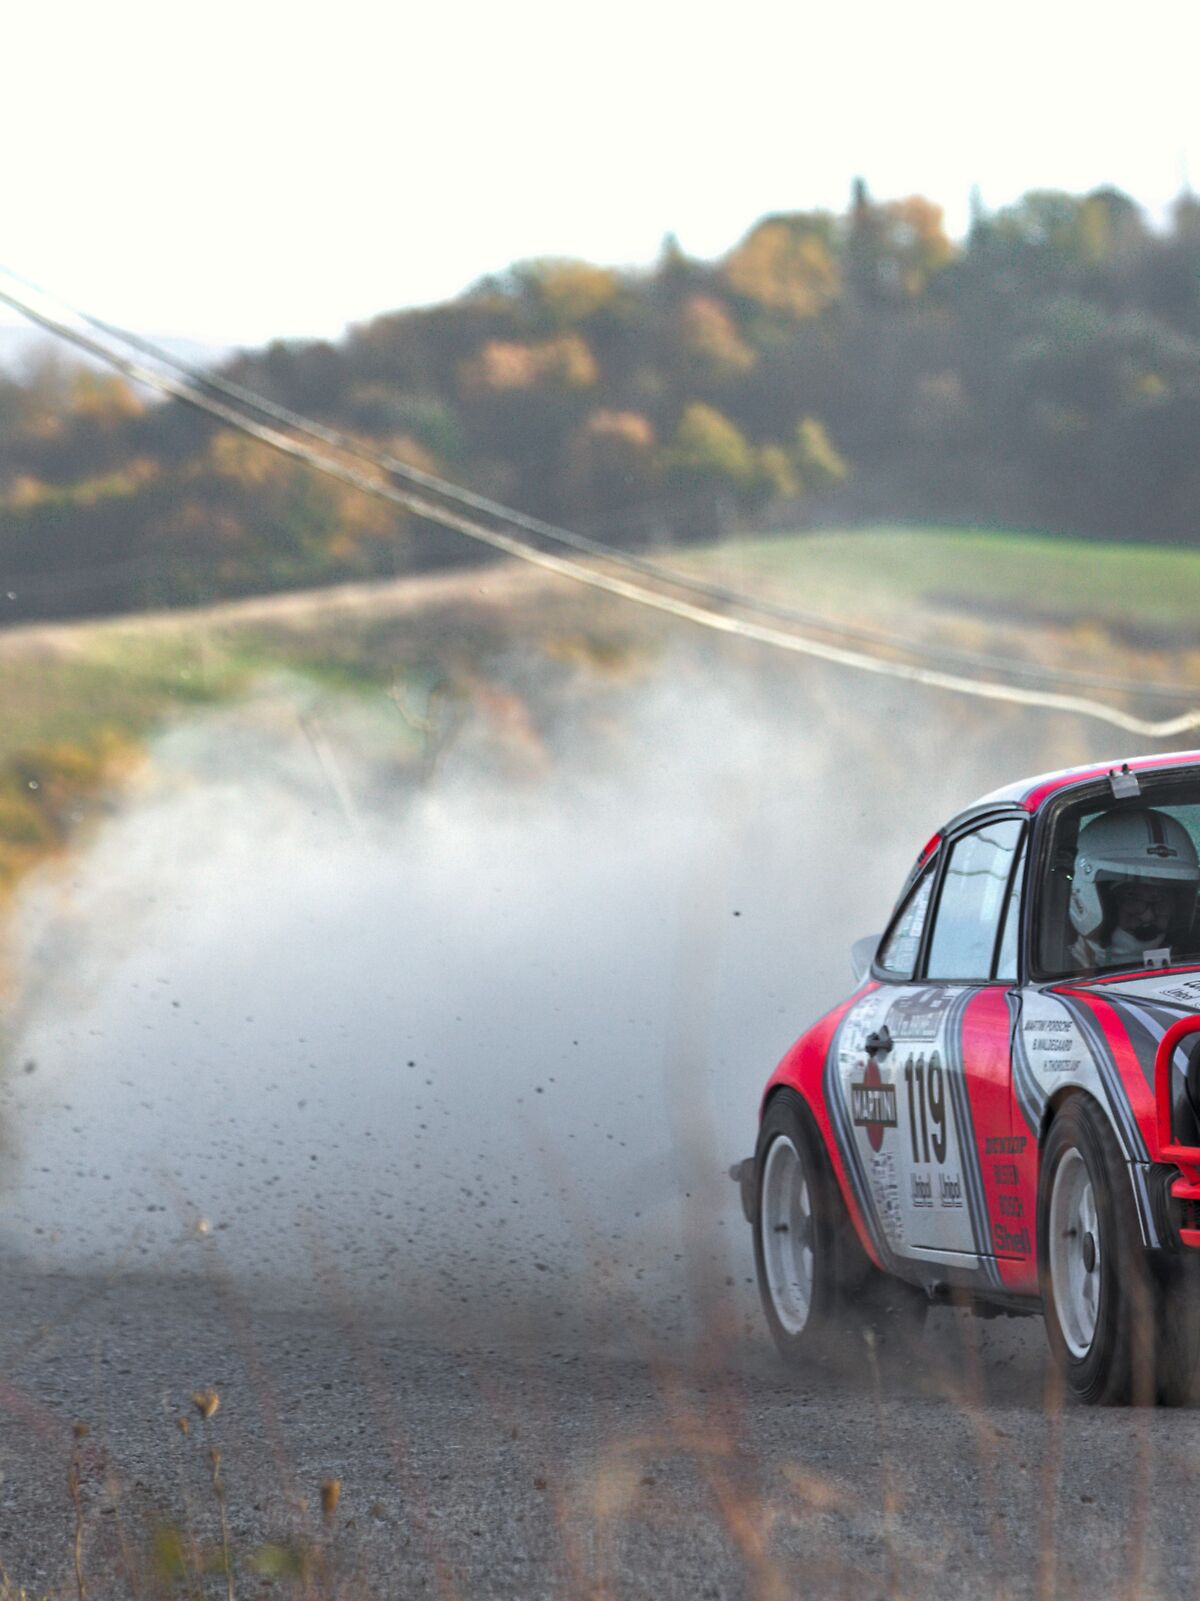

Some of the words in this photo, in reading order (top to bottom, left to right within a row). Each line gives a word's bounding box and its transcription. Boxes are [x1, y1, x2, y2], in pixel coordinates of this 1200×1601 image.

[852, 1089, 897, 1121] MARTINI
[904, 1050, 947, 1164] 119
[994, 1223, 1032, 1254] Shell
